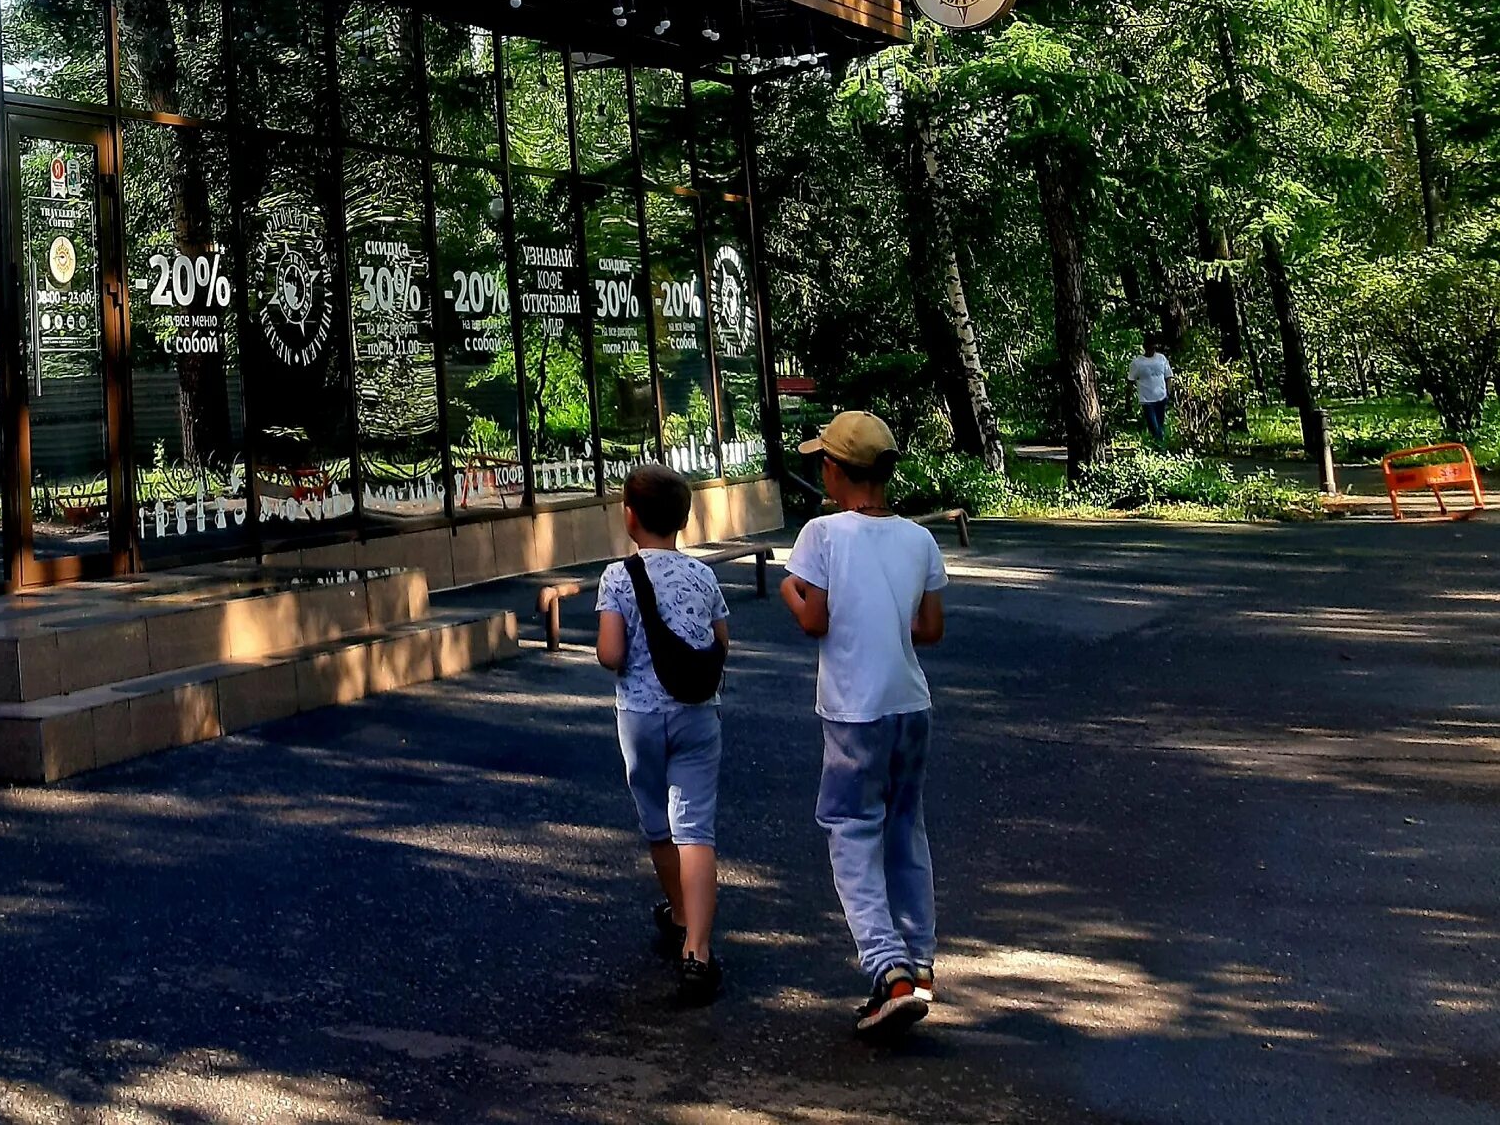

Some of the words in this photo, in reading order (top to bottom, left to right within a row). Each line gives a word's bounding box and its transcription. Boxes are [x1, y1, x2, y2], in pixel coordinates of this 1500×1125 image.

[365, 241, 409, 261] скидка
[522, 244, 572, 267] УЗНАВАЙ
[537, 270, 563, 289] КОФЕ
[522, 289, 580, 313] ОТКРЫВАЙ
[174, 316, 190, 327] все
[192, 315, 217, 327] меню
[462, 320, 470, 329] на
[543, 318, 564, 337] МИР
[176, 330, 218, 353] собой
[465, 337, 471, 351] с
[494, 465, 524, 486] КОФЕ
